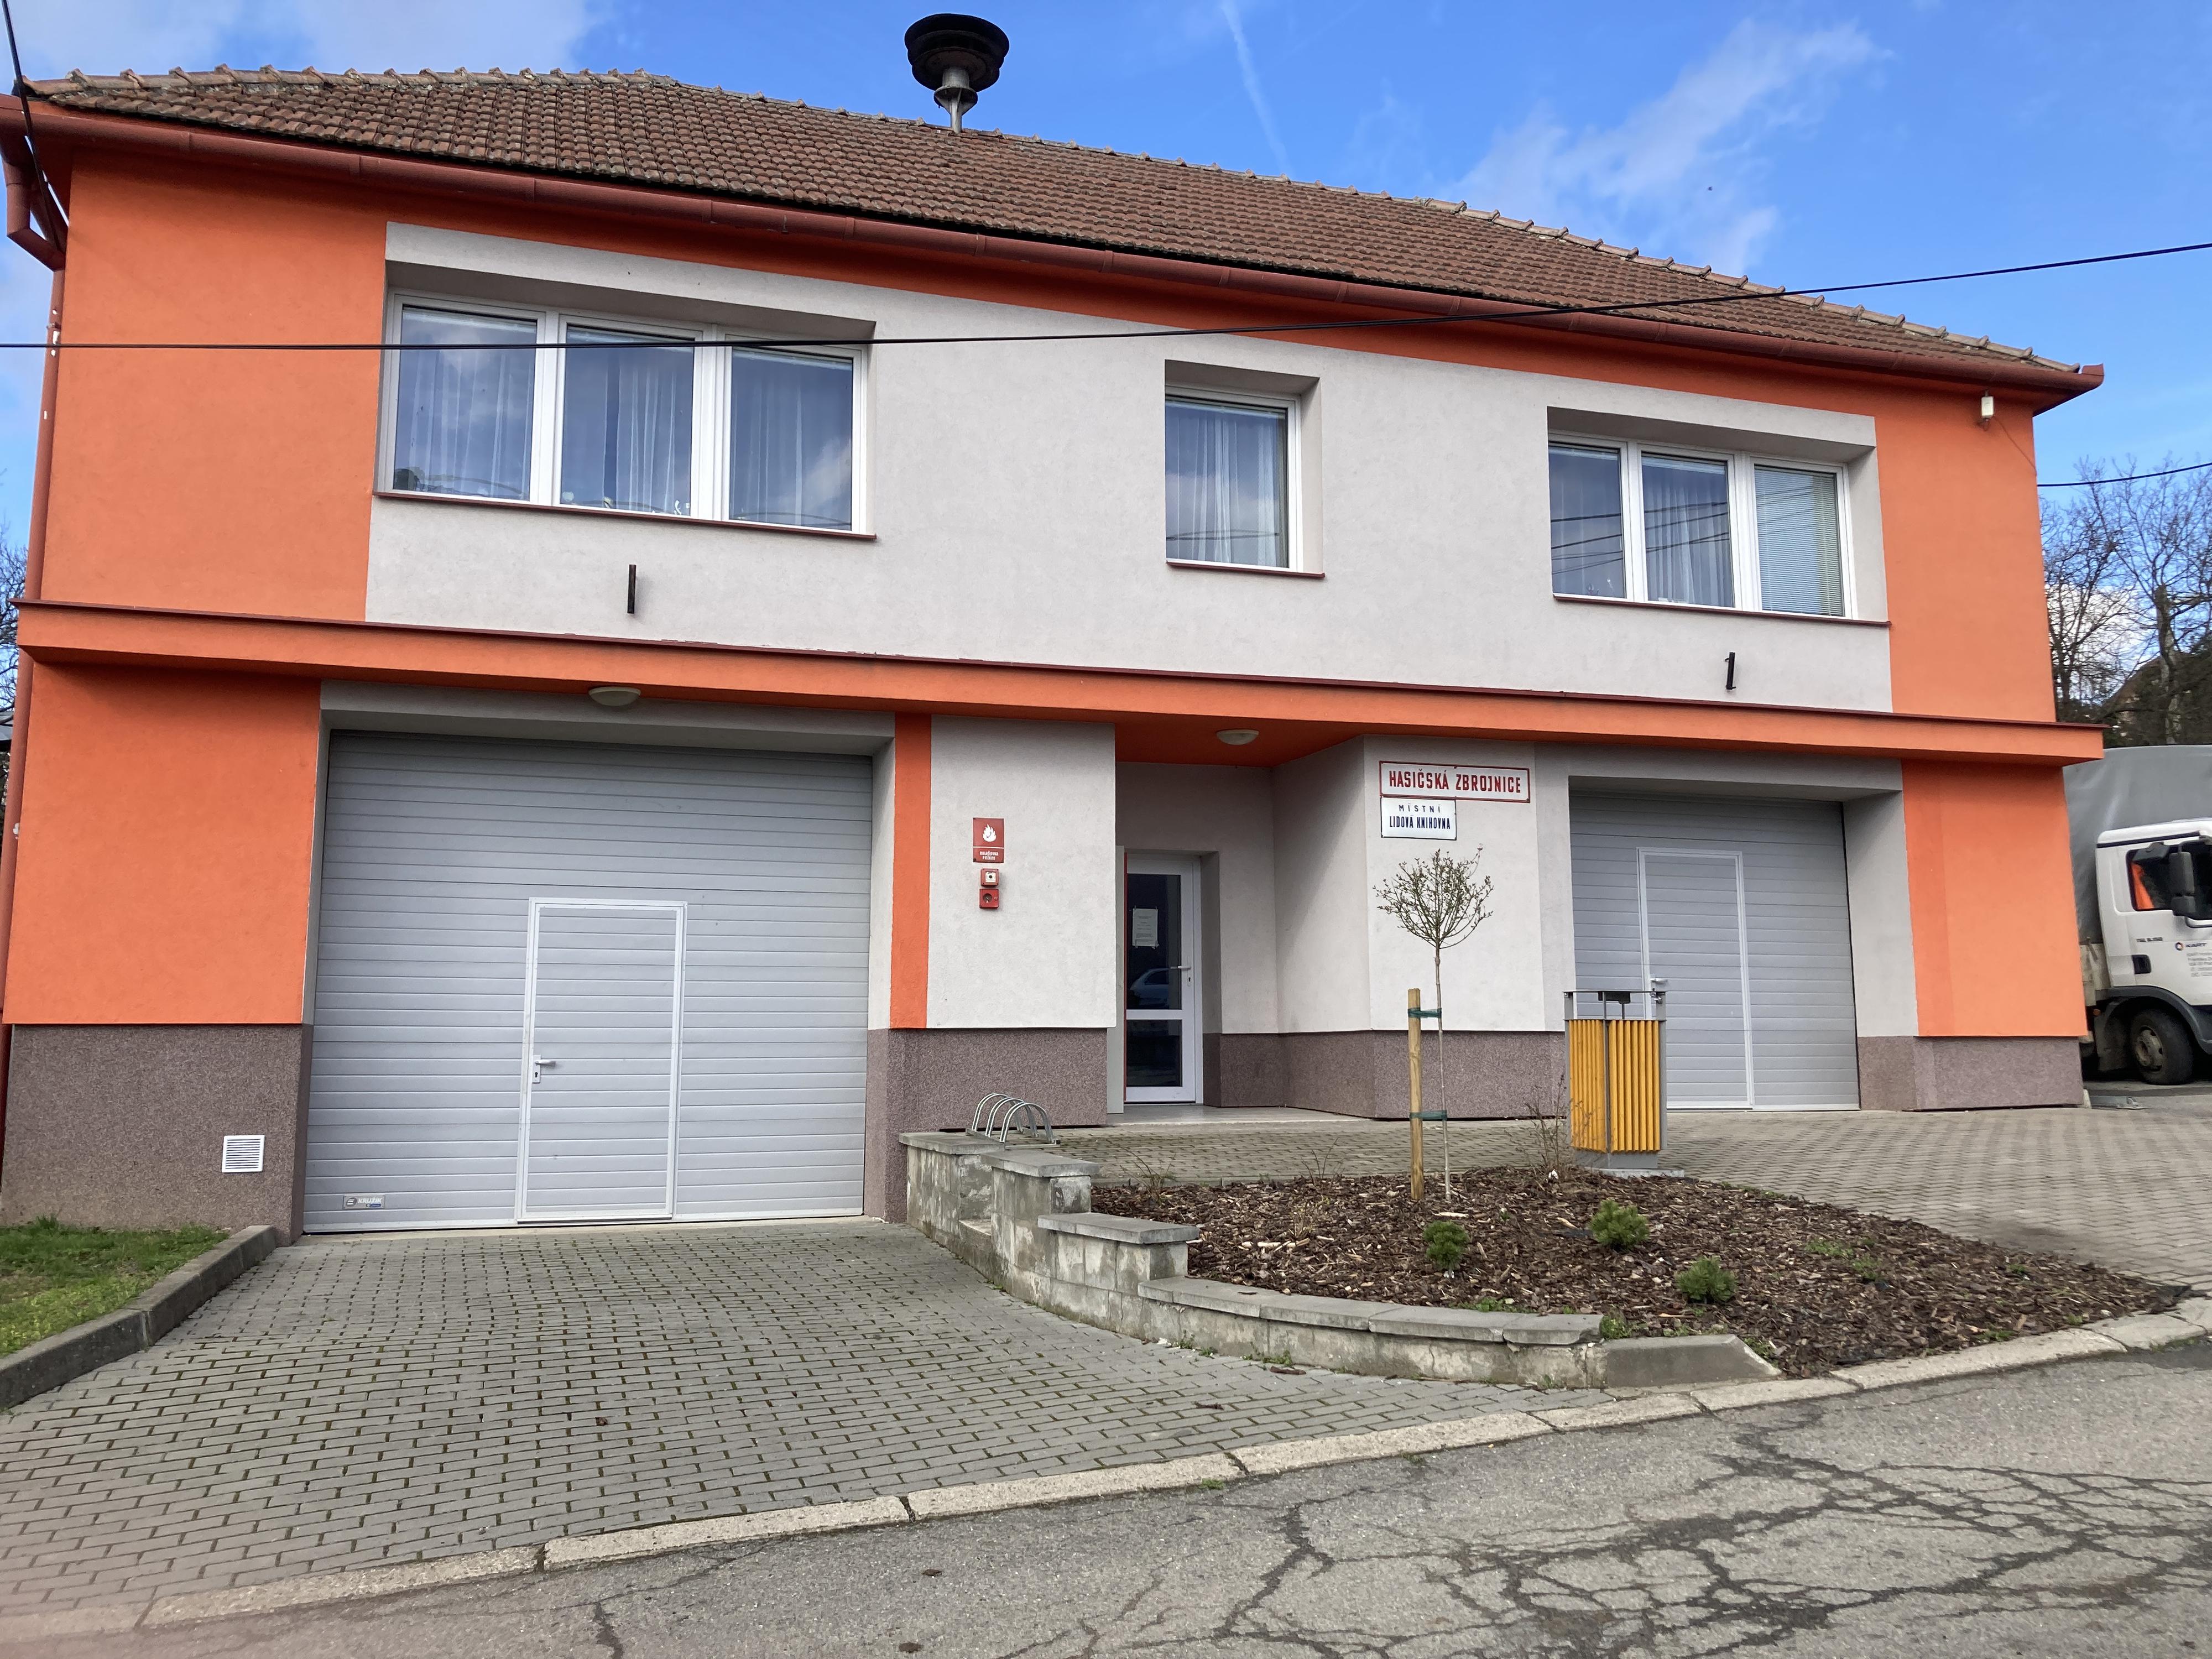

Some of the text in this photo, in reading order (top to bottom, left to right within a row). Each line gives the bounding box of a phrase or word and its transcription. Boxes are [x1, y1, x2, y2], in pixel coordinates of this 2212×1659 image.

[1389, 769, 1521, 793] HASIČSKÁ ZBROJNICE
[1399, 803, 1441, 813] MÍSTNÍ
[1389, 815, 1450, 830] LIDOVÁ KNIHOVNA
